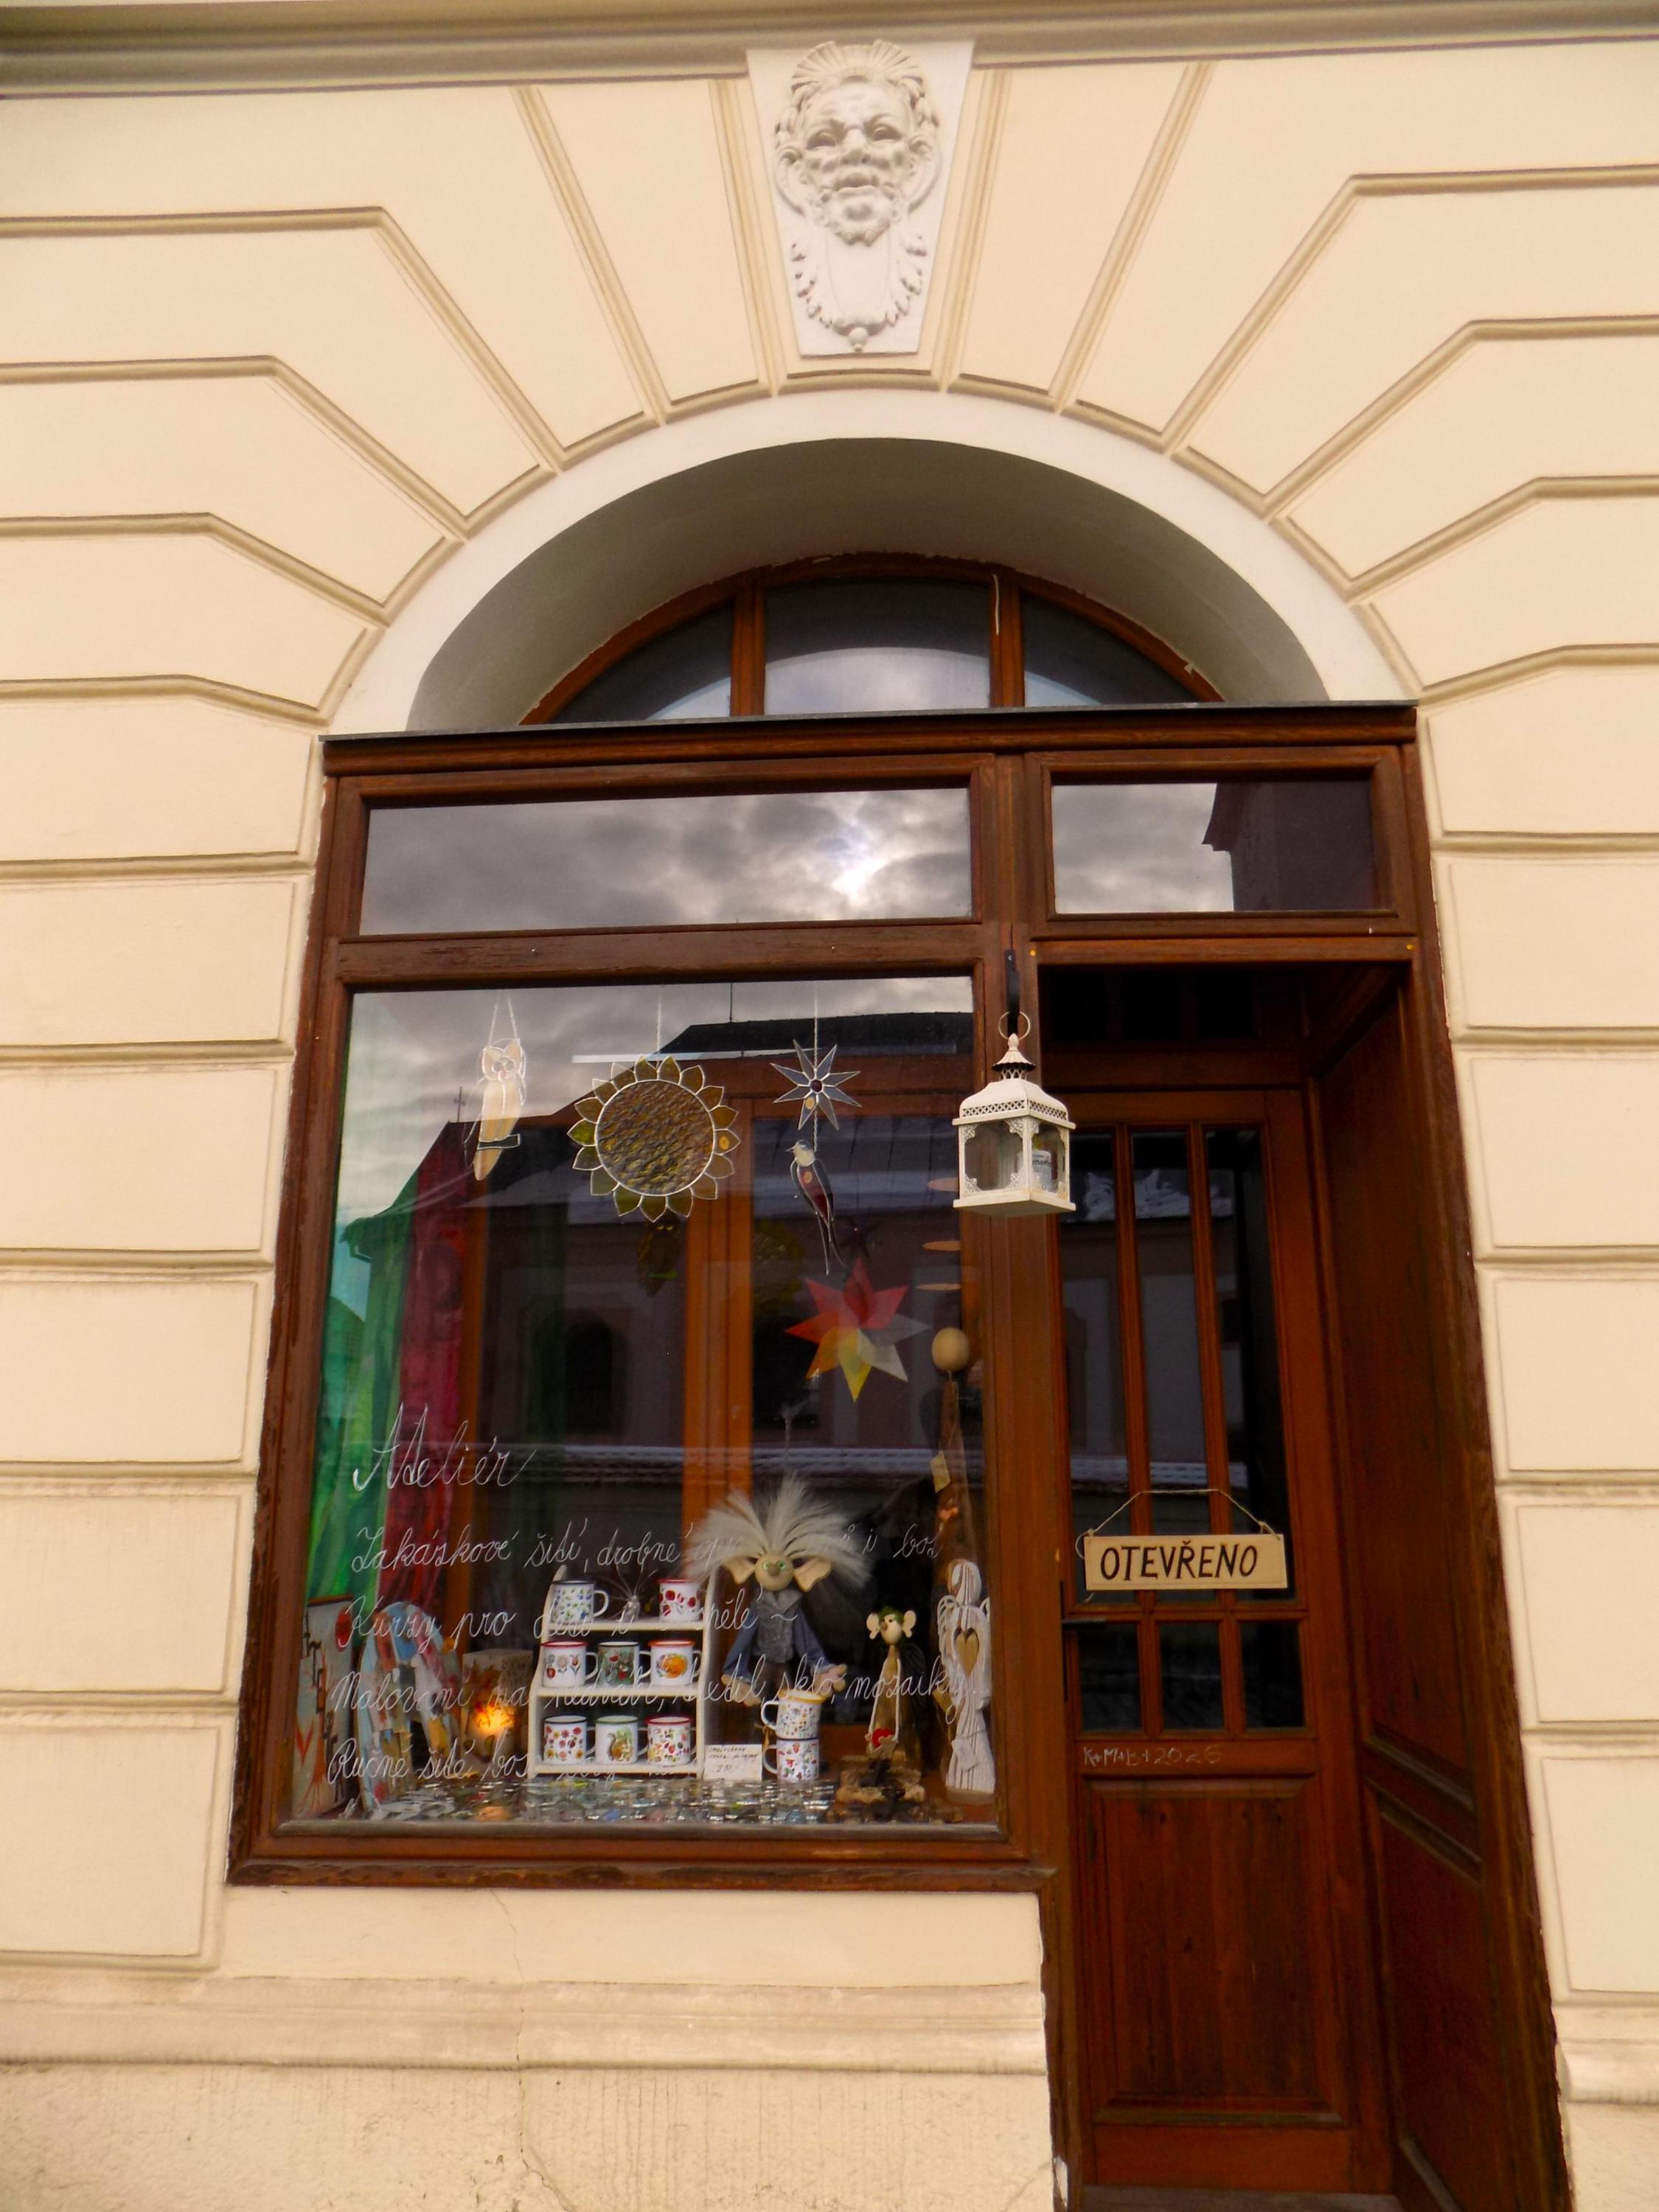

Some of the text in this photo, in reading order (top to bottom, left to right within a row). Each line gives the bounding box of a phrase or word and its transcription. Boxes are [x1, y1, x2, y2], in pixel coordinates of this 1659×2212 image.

[352, 1401, 537, 1492] Ateliér
[1100, 1540, 1258, 1582] OTEVŘENO
[450, 1612, 516, 1651] pro
